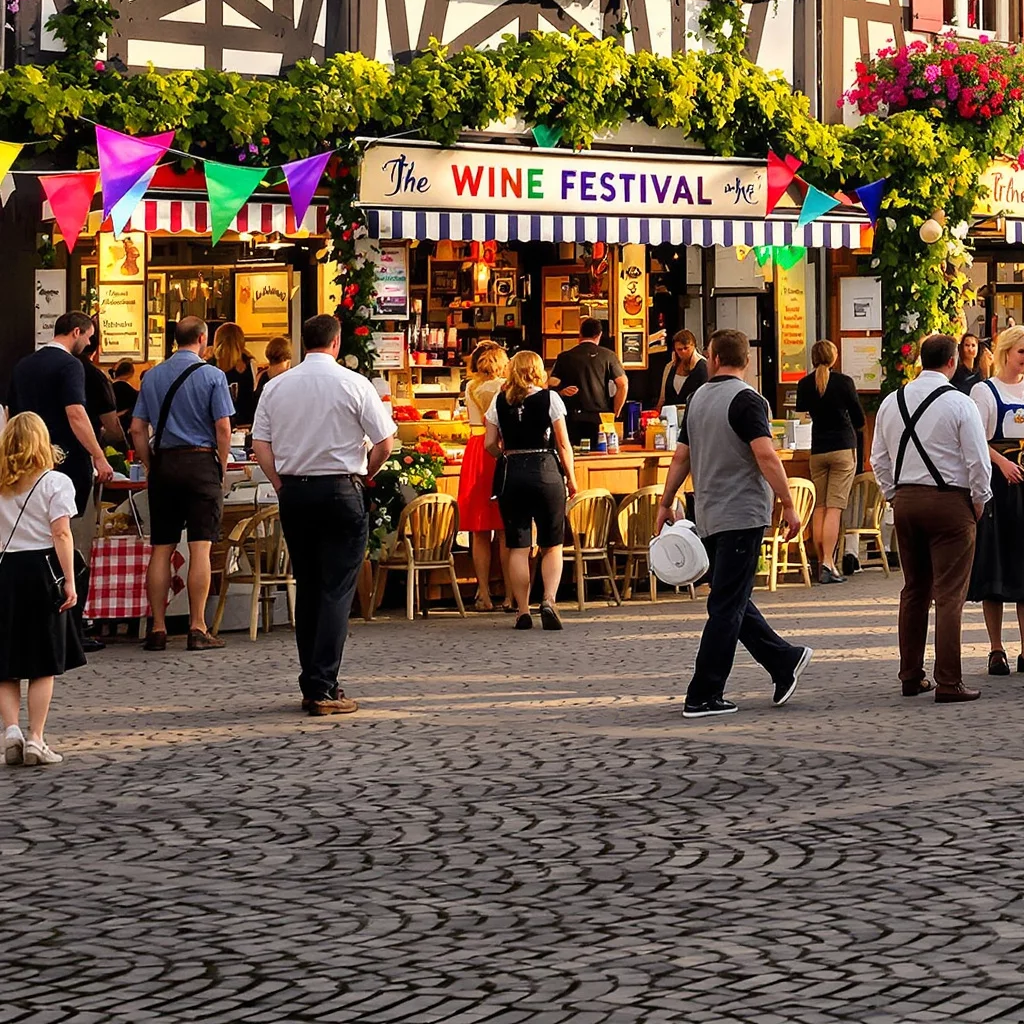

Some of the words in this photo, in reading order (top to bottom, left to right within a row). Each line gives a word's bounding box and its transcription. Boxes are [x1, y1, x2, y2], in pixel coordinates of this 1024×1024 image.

[382, 154, 431, 197] The
[451, 164, 544, 199] WINE
[561, 169, 713, 206] FESTIVAL
